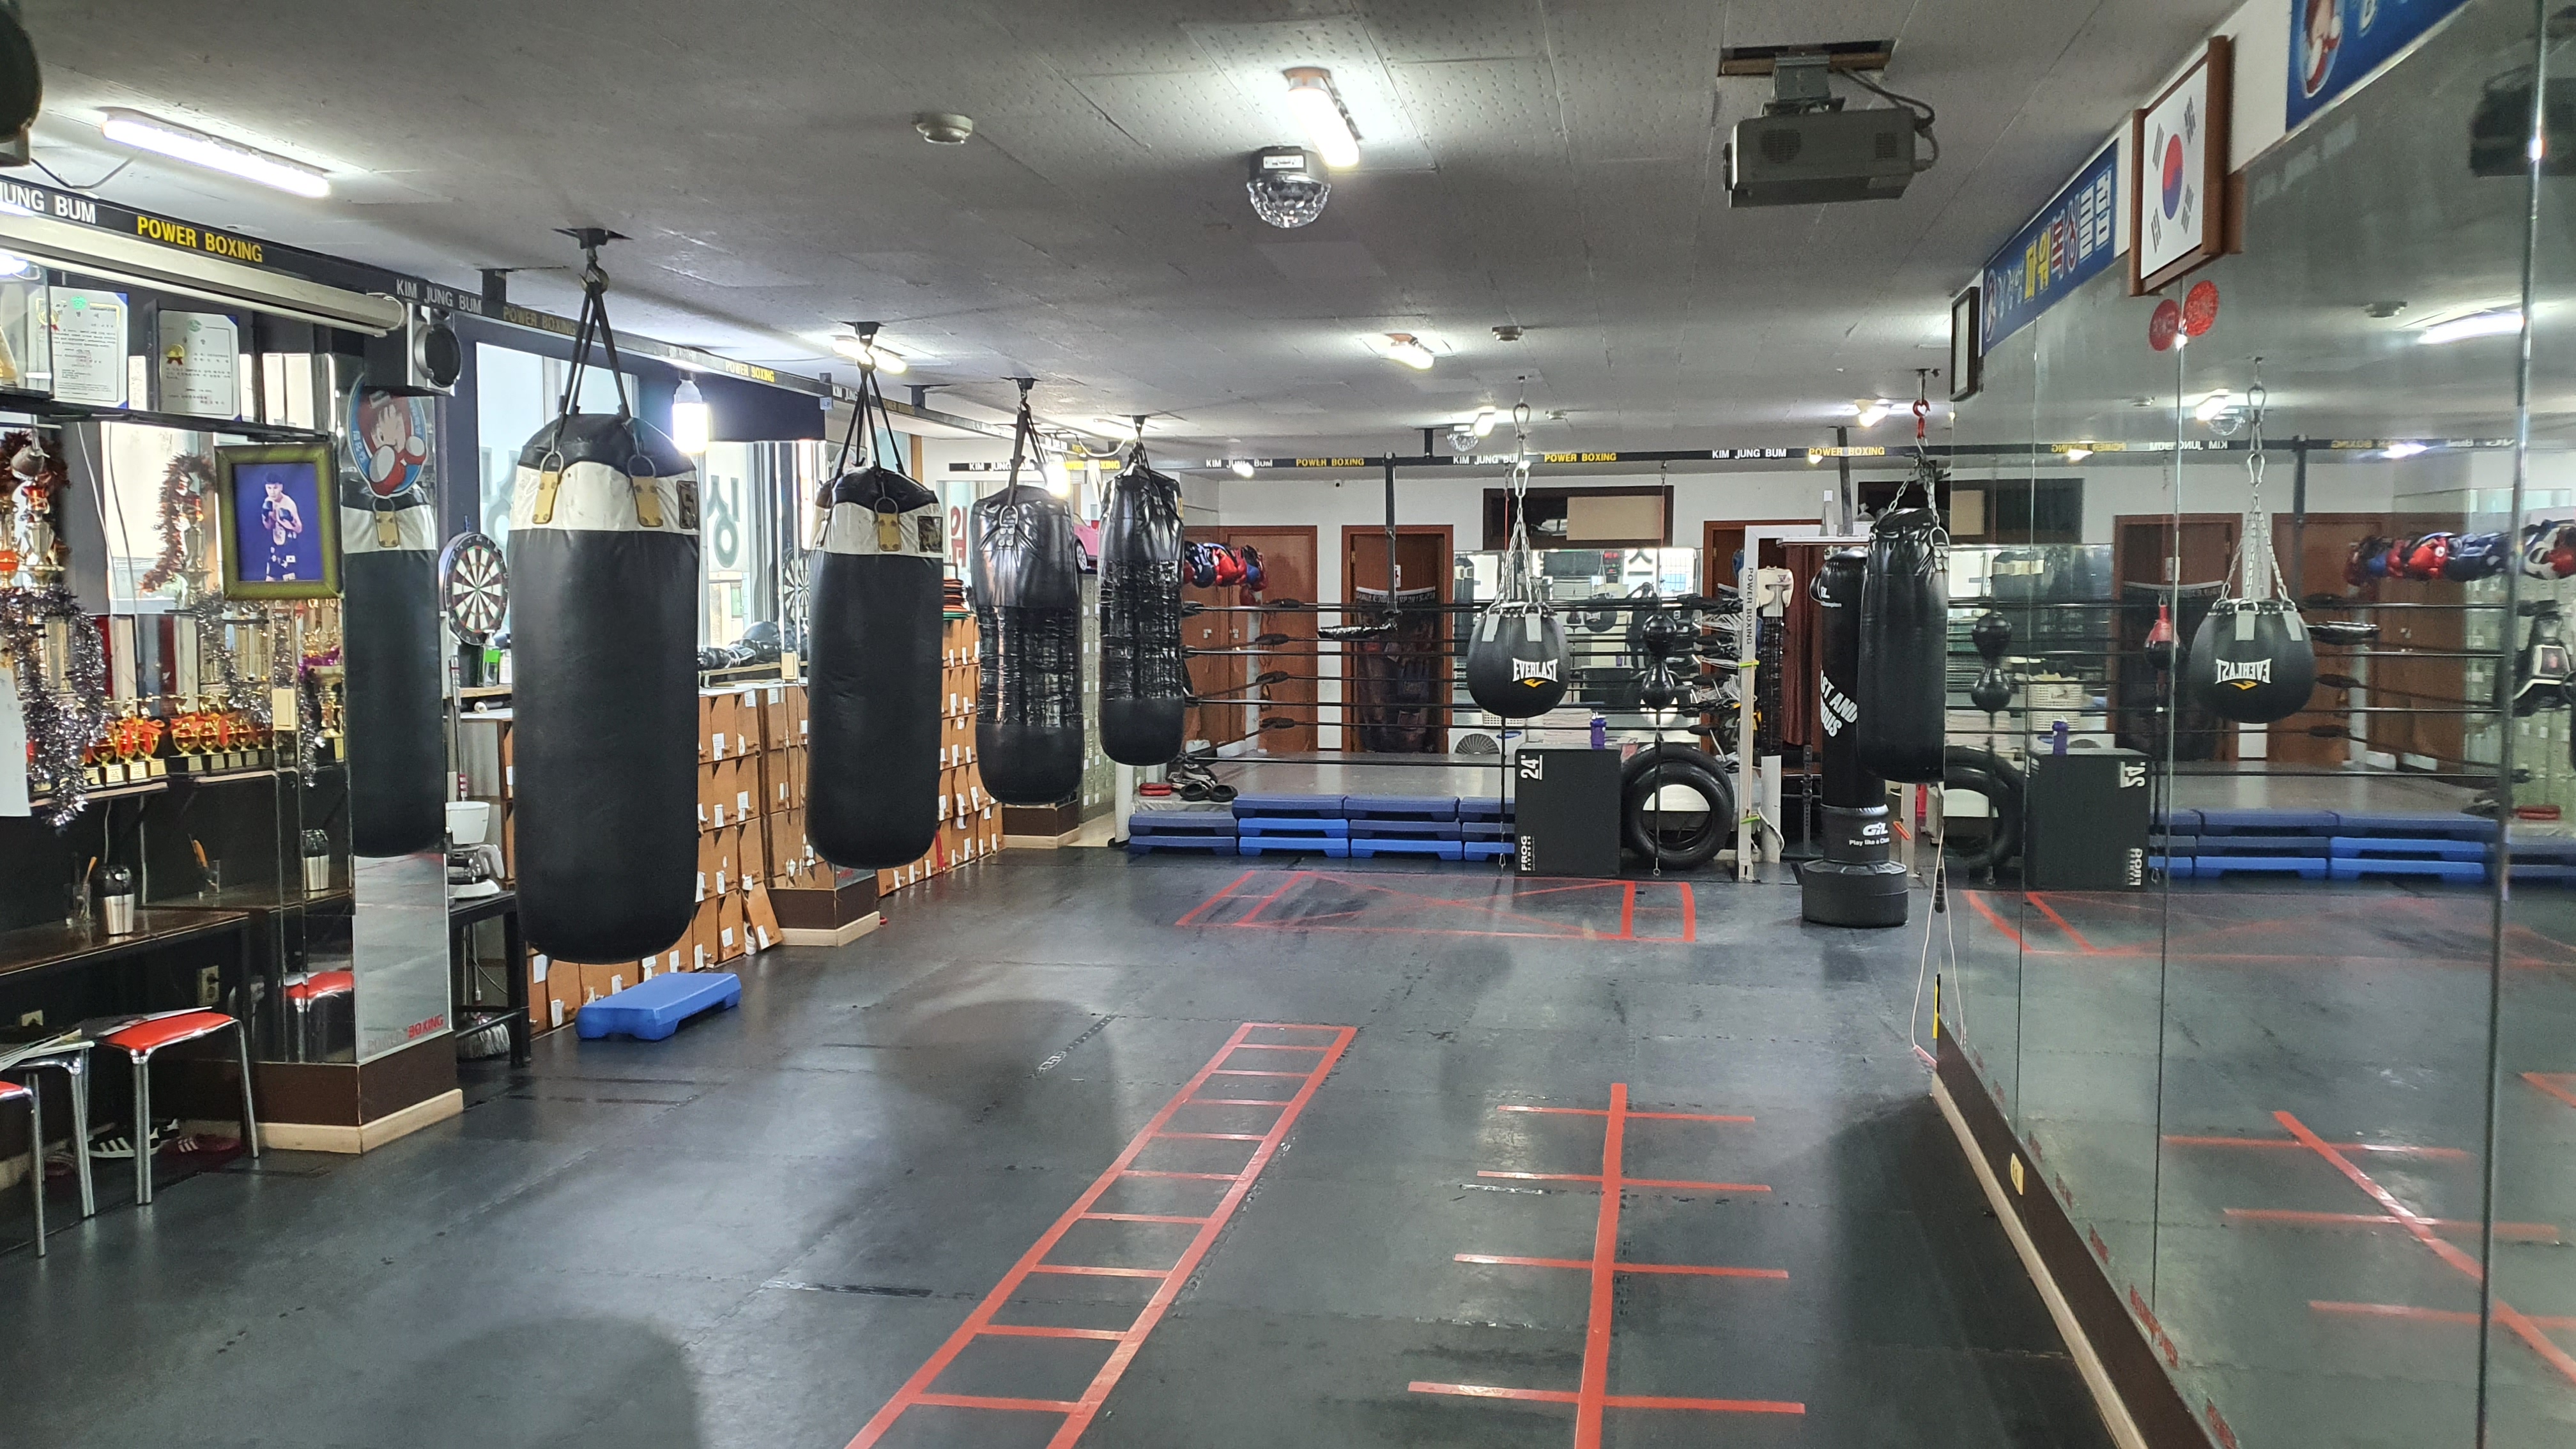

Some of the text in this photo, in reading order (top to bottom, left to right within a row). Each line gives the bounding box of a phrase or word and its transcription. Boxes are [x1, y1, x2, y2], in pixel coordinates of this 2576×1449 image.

[54, 194, 96, 224] BUM
[137, 215, 263, 263] POWER BOXING
[395, 279, 482, 315] KIM JUNG BUM
[502, 305, 576, 335] POWER BOXING
[725, 360, 749, 377] POWER
[1296, 457, 1365, 467] POWER BOXING
[1453, 455, 1520, 465] KIM JUNG BU
[1544, 452, 1617, 463] POWER BOXING
[1712, 448, 1787, 459] KIM JUNG BUM
[1808, 447, 1885, 456] POWER BOXING
[969, 462, 985, 471] KIM
[1206, 459, 1222, 468] KIM
[1254, 458, 1273, 468] BUM
[1745, 567, 1754, 604] POWER
[1512, 657, 1559, 682] EVERLAST
[1829, 692, 1857, 723] AND
[407, 1014, 444, 1039] BOXING
